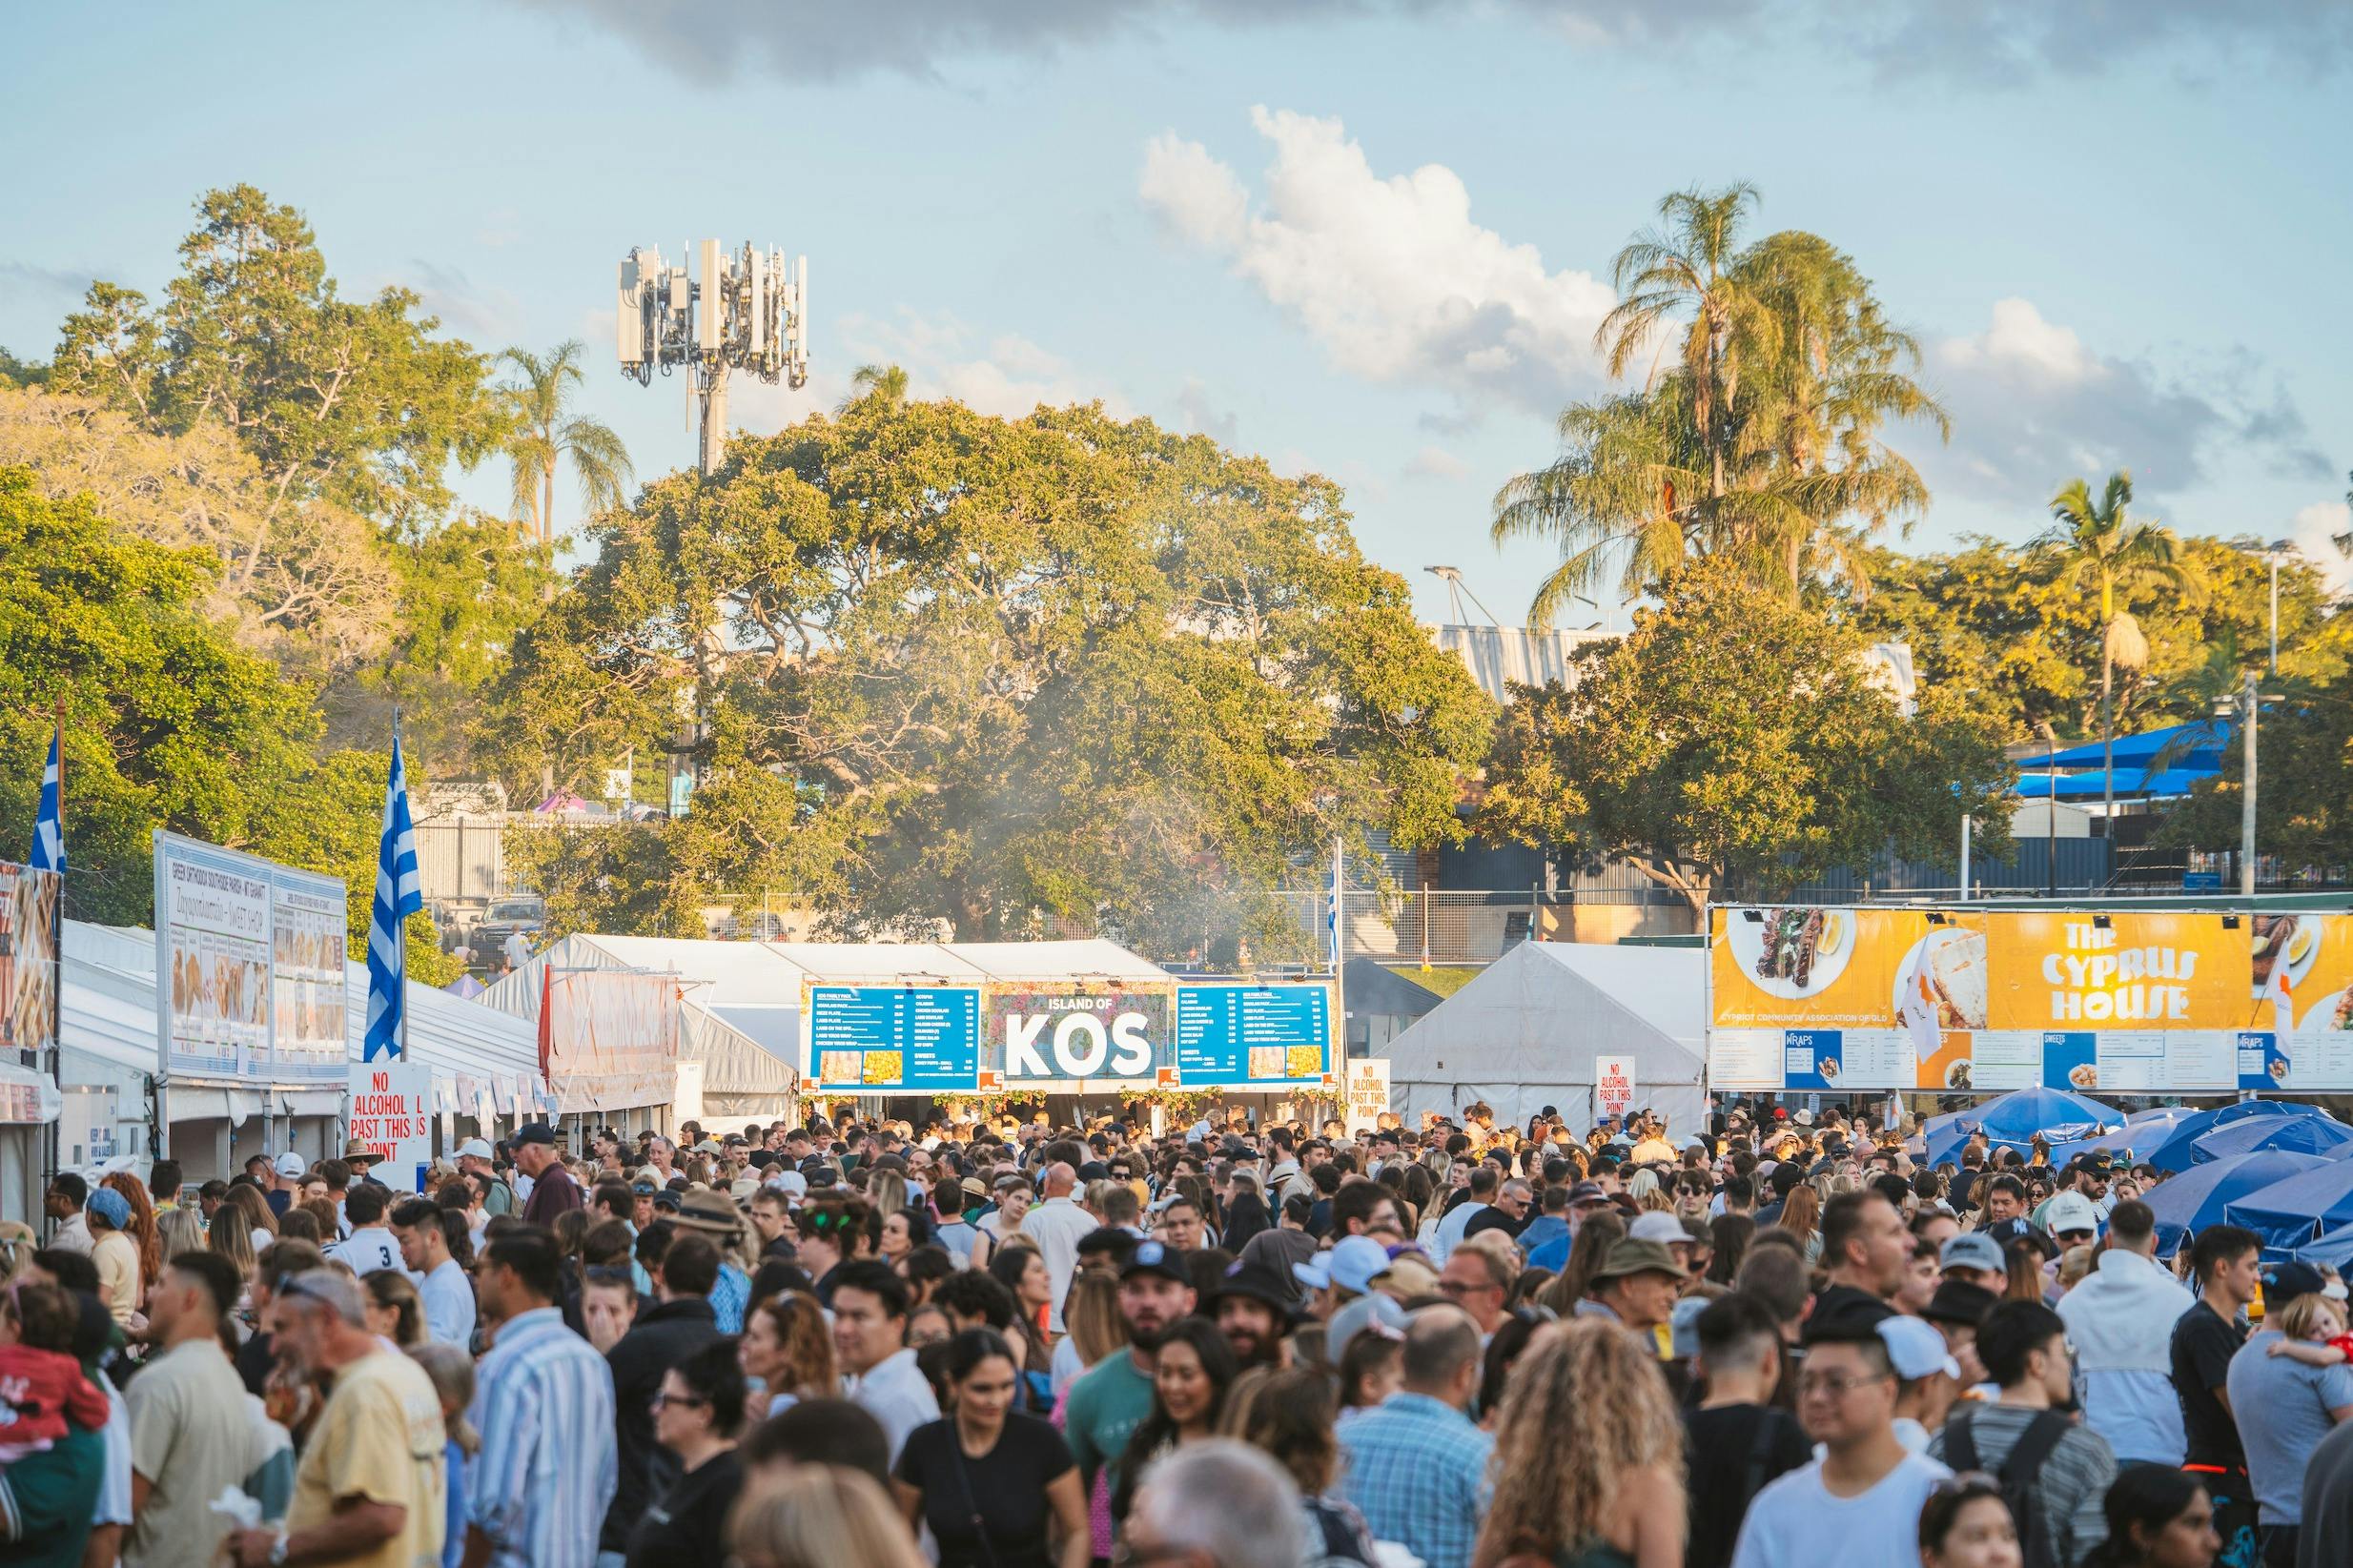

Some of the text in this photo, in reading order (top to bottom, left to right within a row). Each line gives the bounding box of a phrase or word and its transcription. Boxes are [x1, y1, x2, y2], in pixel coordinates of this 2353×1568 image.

[172, 862, 185, 881] GREEK
[229, 901, 246, 930] SWEET
[248, 907, 263, 933] SHOP
[2065, 922, 2117, 949] THE
[2042, 945, 2199, 987] CYPRUS
[1049, 999, 1113, 1010] ISLAND OF
[2052, 984, 2189, 1020] HOUSE
[1757, 1013, 1804, 1022] COMMUNITY
[1006, 1012, 1152, 1076] KOS
[1786, 1033, 1813, 1047] WRAPS
[2044, 1034, 2066, 1045] SWEETS
[2239, 1035, 2264, 1049] WRAPS
[1363, 1066, 1373, 1078] NO
[1611, 1064, 1619, 1075] NO
[373, 1072, 388, 1092] NO
[1353, 1079, 1384, 1091] ALCOHOL
[1601, 1076, 1629, 1088] ALCOHOL
[1350, 1092, 1386, 1105] PAST THIS
[1600, 1089, 1631, 1100] PAST THIS
[354, 1095, 407, 1115] ALCOHOL
[1358, 1106, 1378, 1118] POINT
[1606, 1102, 1624, 1114] POINT
[351, 1118, 410, 1139] PAST THIS
[379, 1245, 391, 1267] 3
